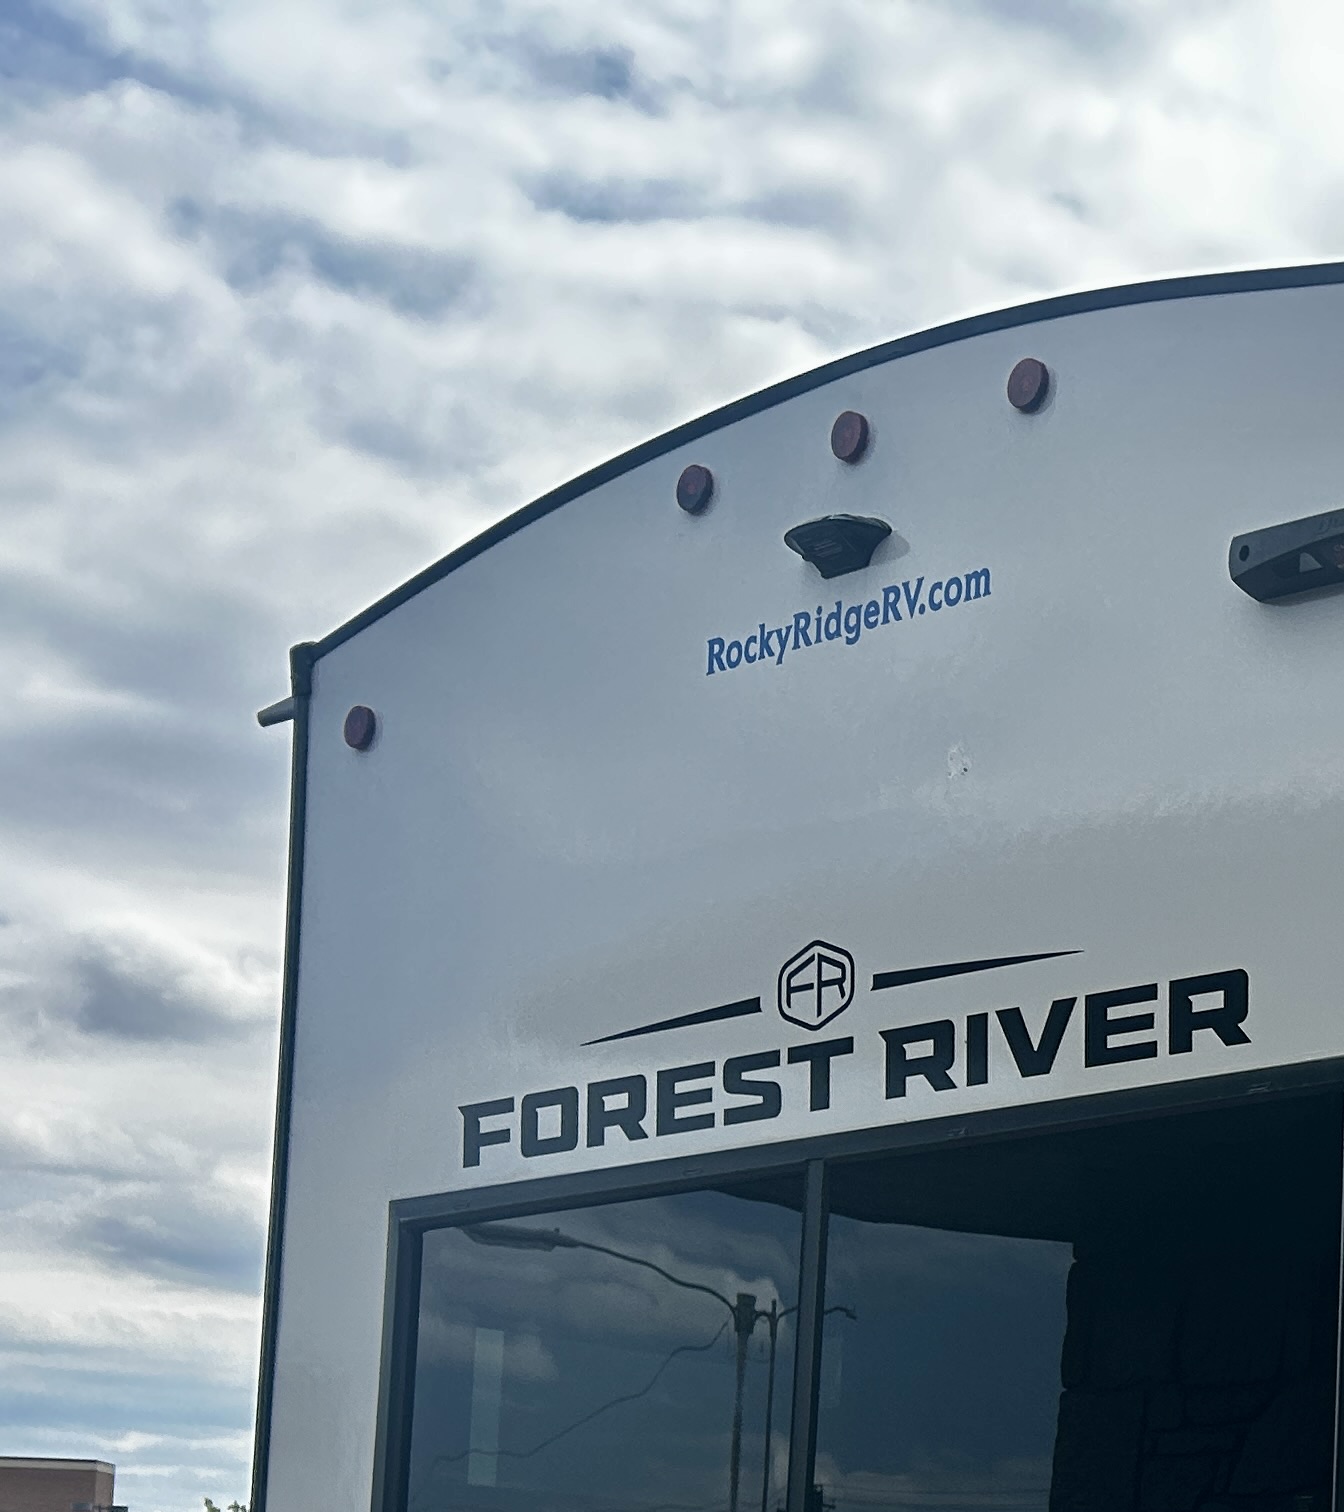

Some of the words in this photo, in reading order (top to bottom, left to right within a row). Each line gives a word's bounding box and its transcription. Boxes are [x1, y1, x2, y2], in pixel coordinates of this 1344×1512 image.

[706, 567, 992, 675] RockyRidgeRV.com
[458, 1035, 854, 1169] FOREST
[878, 968, 1252, 1100] RIVER
